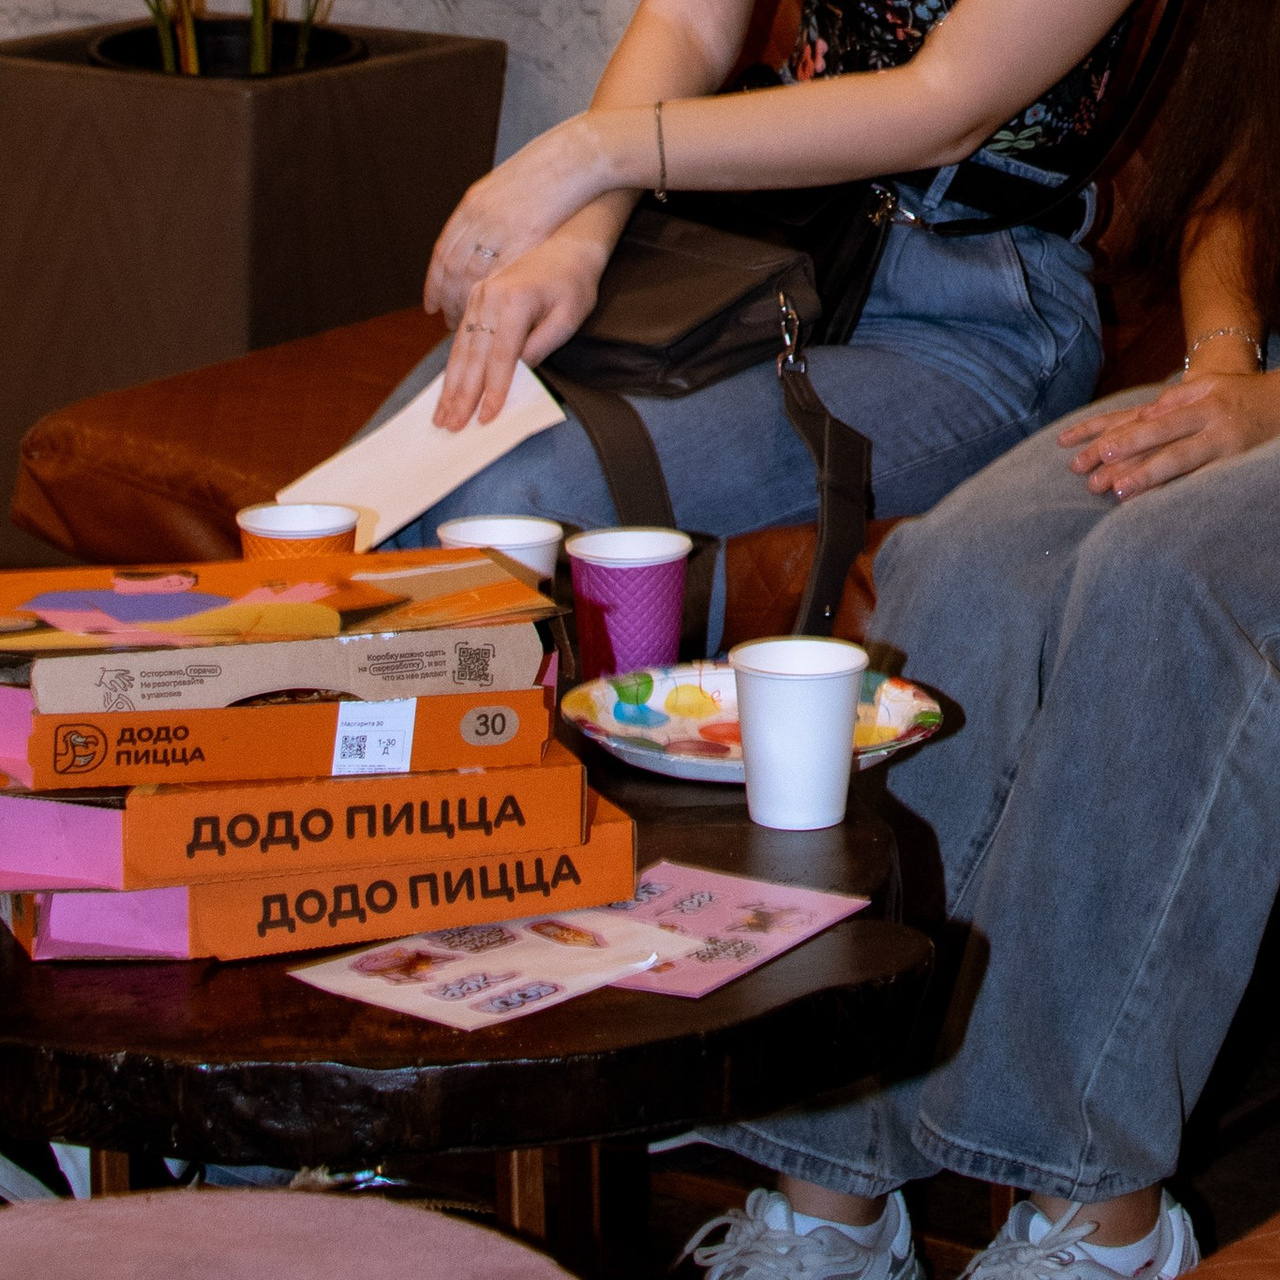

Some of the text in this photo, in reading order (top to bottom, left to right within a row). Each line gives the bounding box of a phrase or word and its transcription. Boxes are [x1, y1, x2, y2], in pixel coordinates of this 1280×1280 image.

[367, 649, 446, 661] Коробку можно сдать
[152, 677, 204, 689] разогревайте
[382, 673, 396, 681] что
[420, 670, 448, 679] делают
[147, 691, 182, 700] упаковке
[475, 712, 506, 737] 30
[116, 725, 190, 746] ДОДО
[377, 738, 397, 747] 1-30
[115, 746, 206, 767] ПИЦЦА
[186, 794, 526, 859] ДОДО ПИЦЦА
[257, 879, 399, 938] ДОДО
[408, 854, 582, 910] ПИЦЦА
